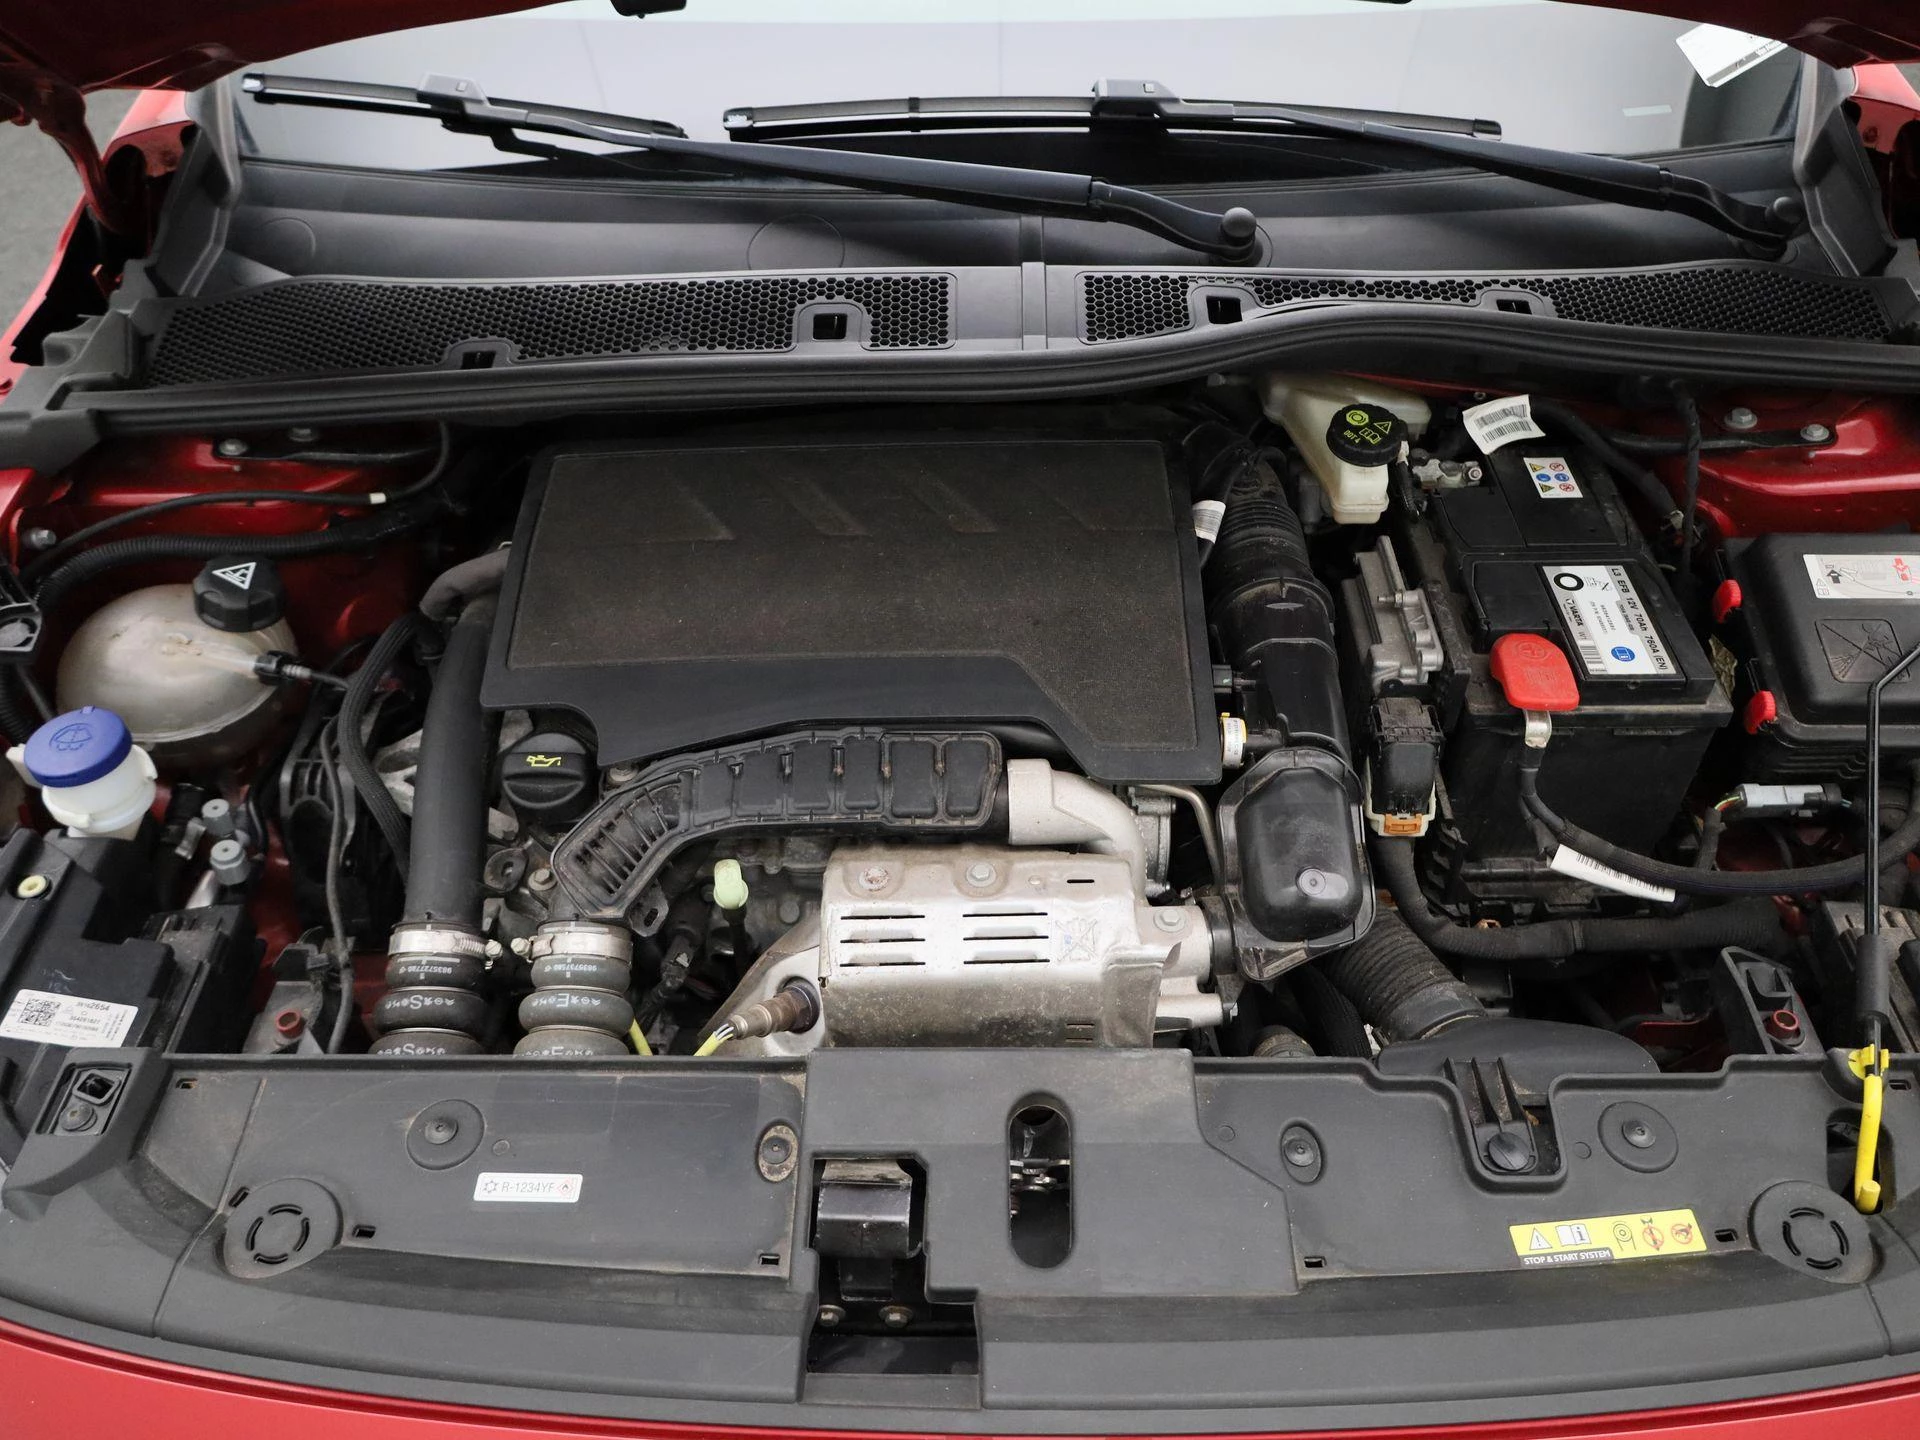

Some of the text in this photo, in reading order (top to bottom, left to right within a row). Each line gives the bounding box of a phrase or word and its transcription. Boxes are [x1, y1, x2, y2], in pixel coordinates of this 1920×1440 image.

[1344, 430, 1358, 439] DOT
[1568, 605, 1584, 626] VARTA
[1611, 568, 1668, 669] L3 EFB 12V 70Ah 760A (EN)
[501, 1181, 555, 1193] R-1234YF
[1524, 1256, 1545, 1265] STOP
[1553, 1253, 1579, 1263] START
[1580, 1250, 1611, 1260] SYSTEM
